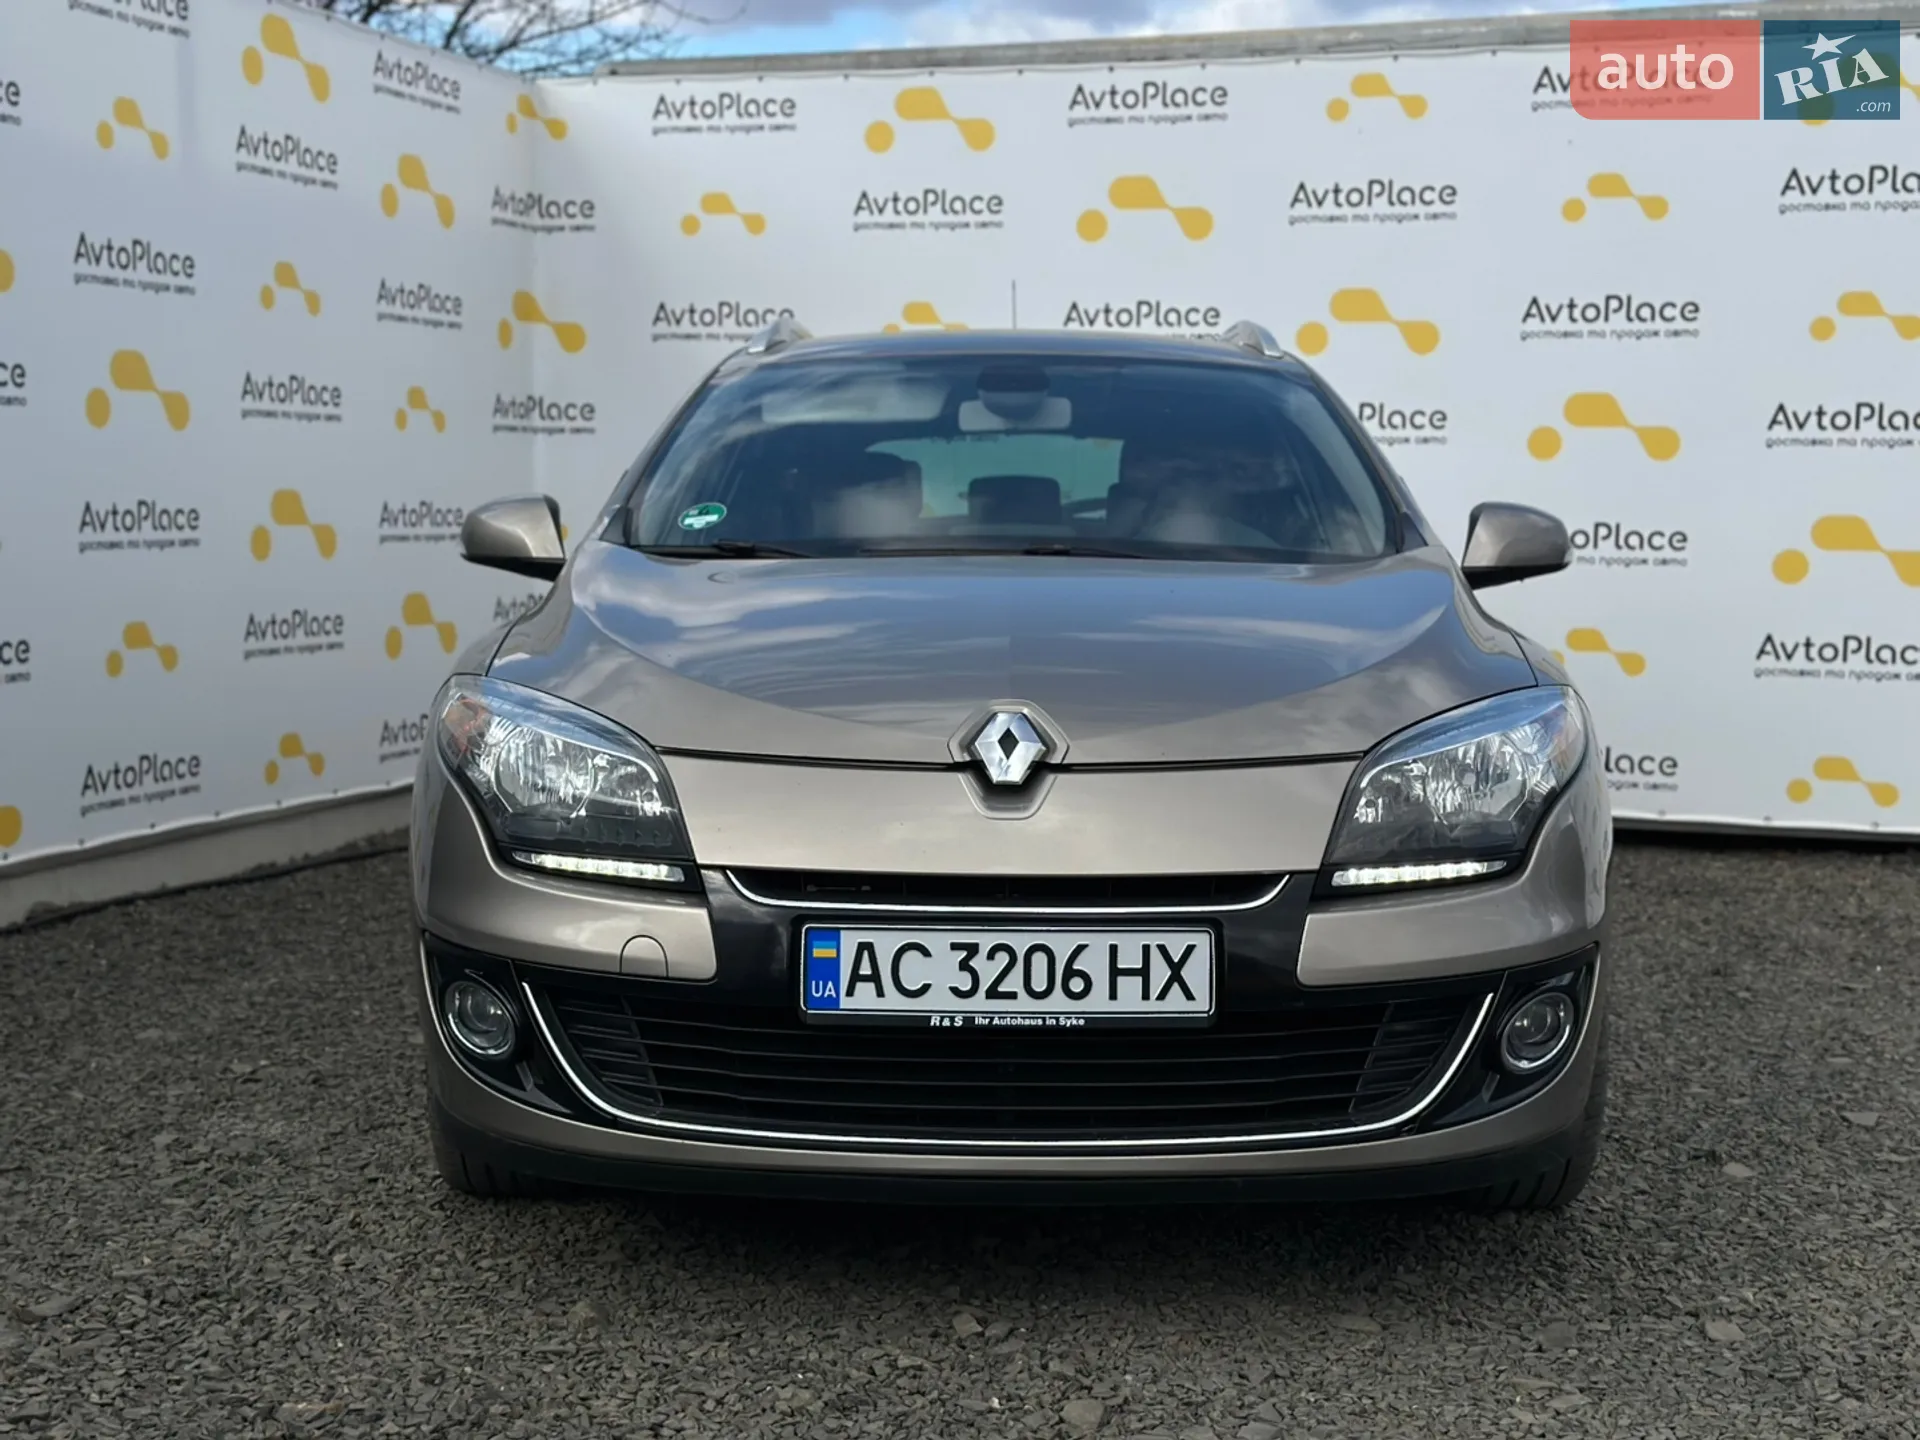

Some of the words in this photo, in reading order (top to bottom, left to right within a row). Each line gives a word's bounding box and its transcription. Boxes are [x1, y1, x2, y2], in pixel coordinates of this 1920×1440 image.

[374, 50, 461, 101] AvtoPlace
[652, 92, 796, 120] AvtoPlace
[1068, 81, 1228, 110] AvtoPlace
[236, 124, 339, 174] AvtoPlace
[1290, 178, 1458, 208] AvtoPlace
[1780, 165, 1920, 197] AvtoPla
[853, 188, 1004, 216] AvtoPlace
[74, 231, 195, 278] AvtoPlace
[377, 277, 462, 316] AvtoPlace
[1521, 294, 1700, 324] AvtoPlace
[1063, 300, 1220, 327] AvtoPlace
[241, 372, 342, 407] AvtoPlace
[1358, 401, 1447, 430] Place
[1767, 402, 1920, 431] AvtoPla
[79, 499, 200, 533] AvtoPlace
[379, 500, 464, 528] AvtoPlace
[1570, 522, 1688, 551] oPlace
[244, 609, 344, 641] AvtoPlace
[1756, 633, 1920, 666] AvtoPlac
[379, 714, 429, 747] AvtoP
[80, 753, 200, 797] AvtoPlace
[845, 940, 933, 999] AC
[947, 942, 1094, 1000] 3206
[1107, 942, 1197, 1001] HX
[811, 980, 837, 998] UA
[930, 1016, 941, 1026] R
[942, 1017, 950, 1026] &
[954, 1016, 963, 1026] S
[975, 1016, 990, 1025] Ihr
[992, 1017, 1042, 1025] Autohaus
[1046, 1017, 1056, 1025] in
[1059, 1017, 1085, 1027] Syke
